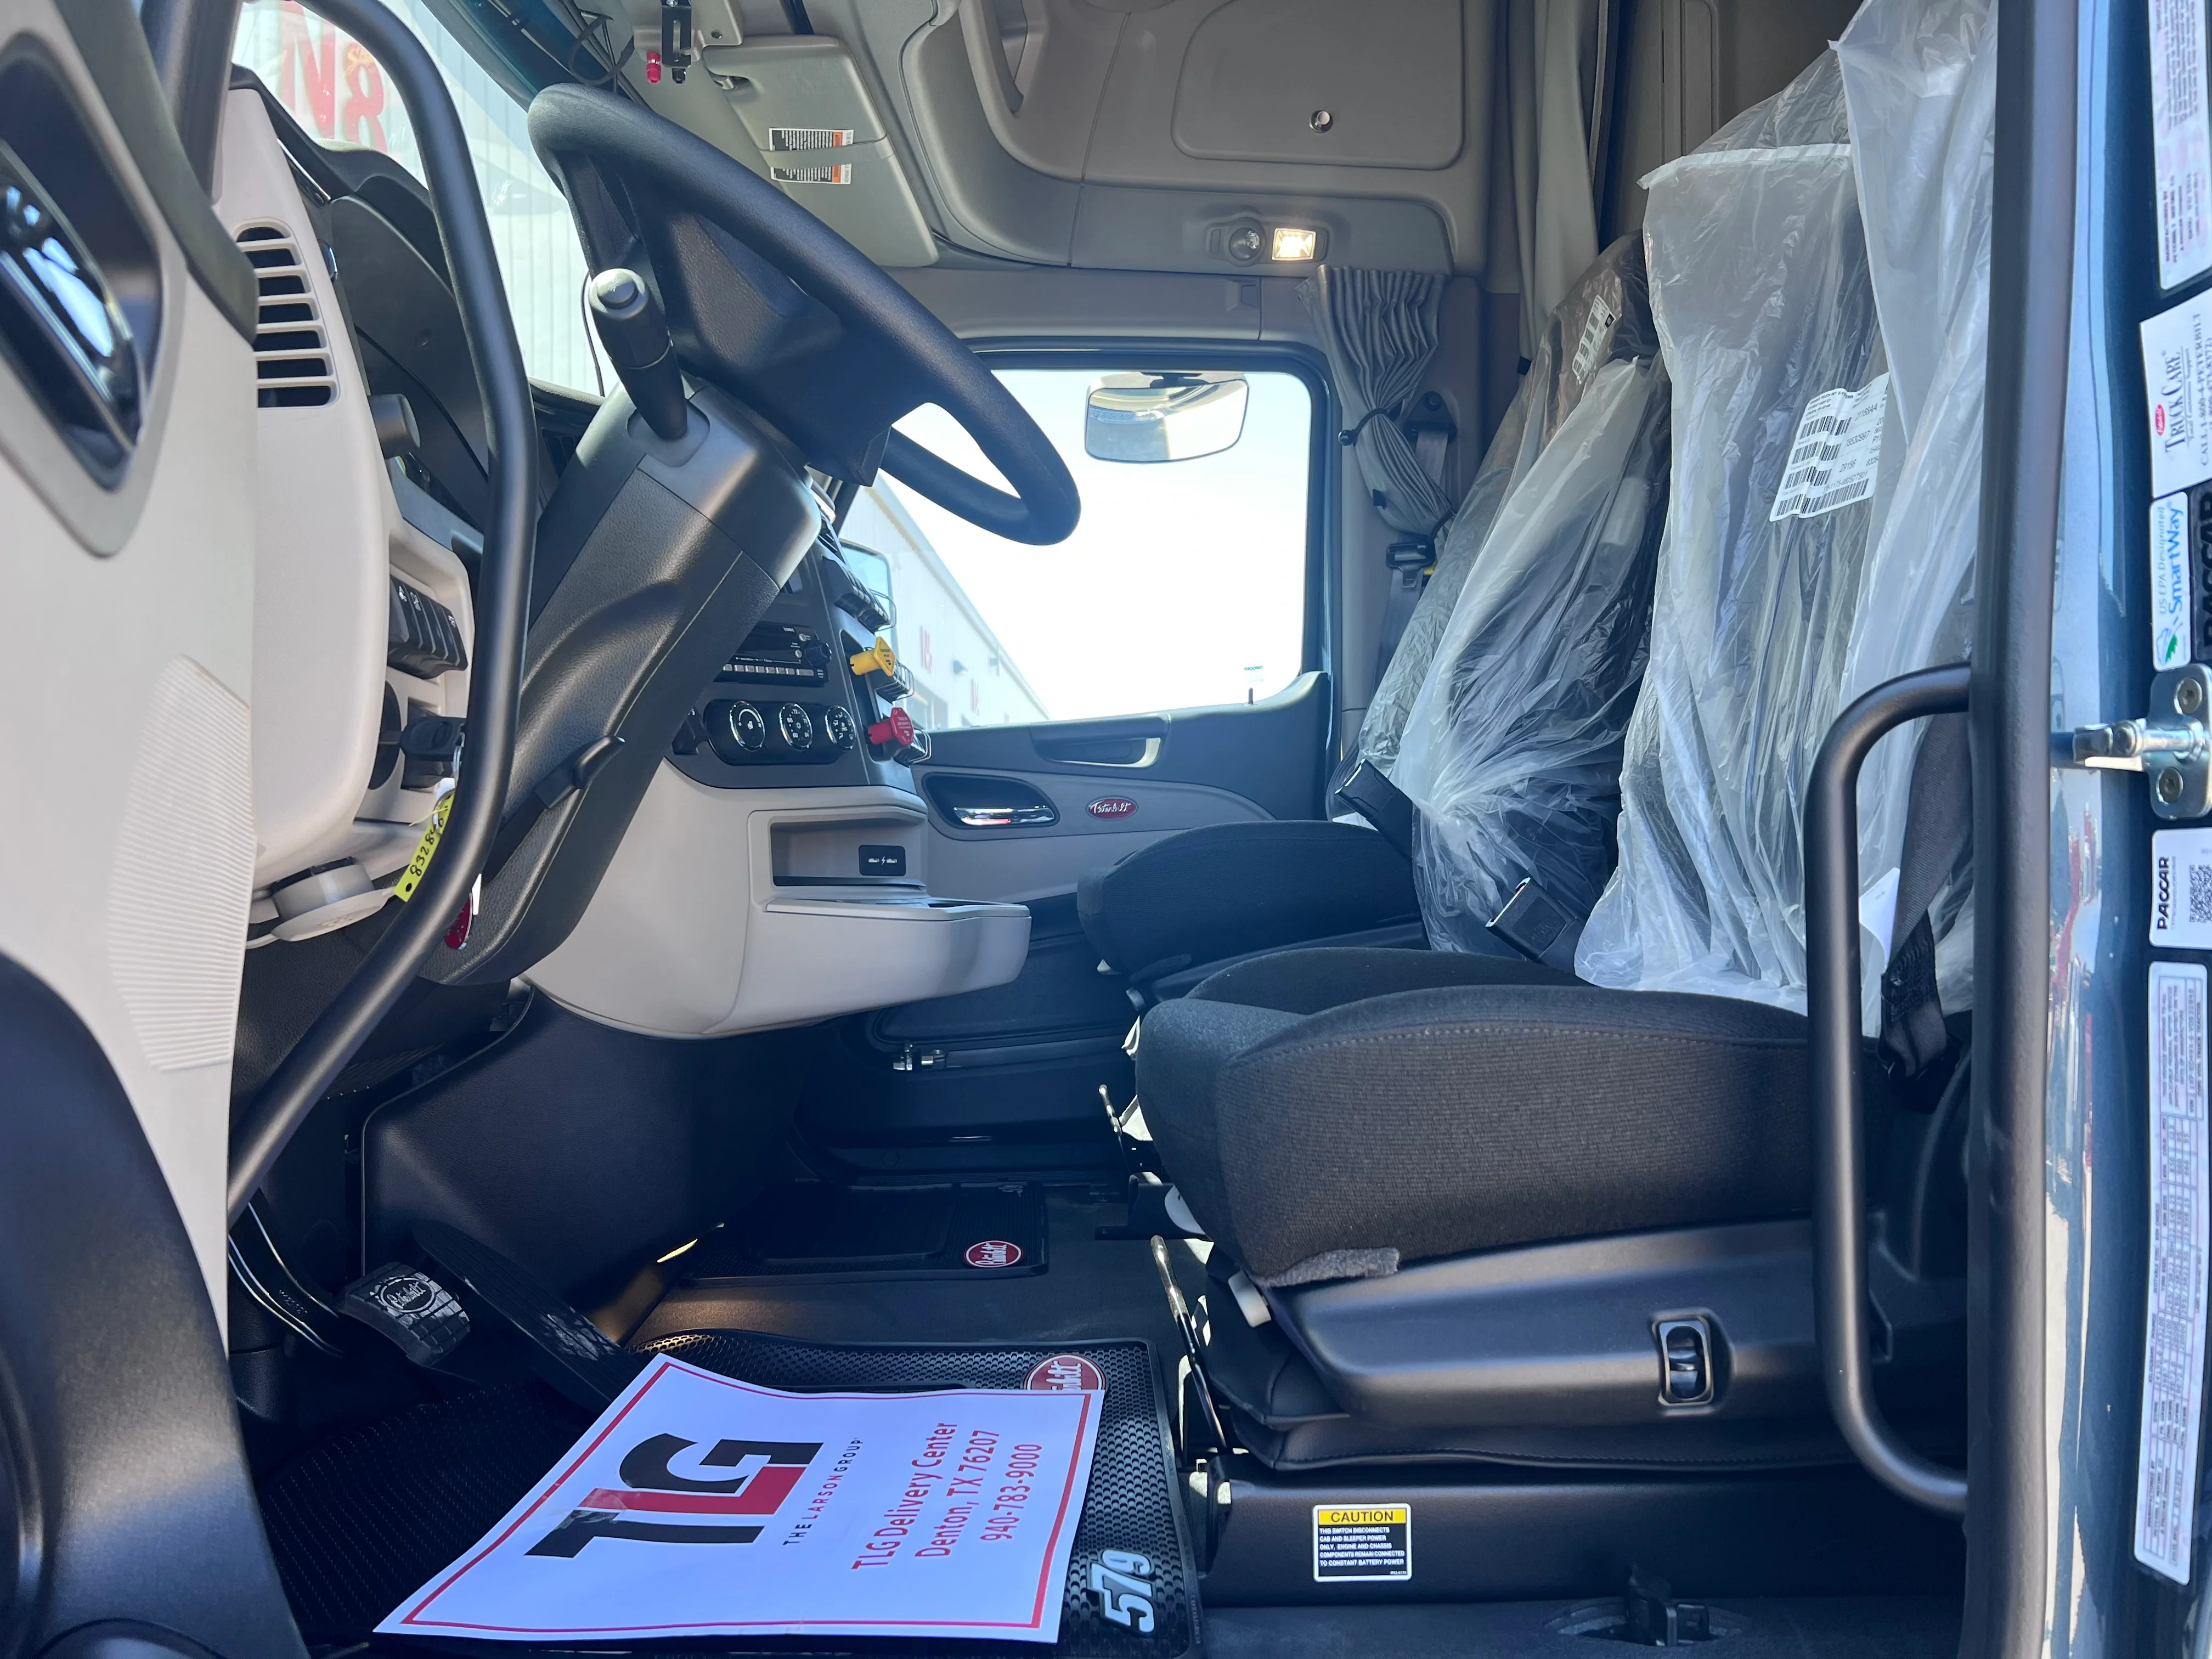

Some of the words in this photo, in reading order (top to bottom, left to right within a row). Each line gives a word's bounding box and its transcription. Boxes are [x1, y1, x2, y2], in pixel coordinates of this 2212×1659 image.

[2160, 351, 2182, 396] CARE
[2164, 395, 2186, 453] TRUCK
[2158, 506, 2168, 573] Designated
[2167, 508, 2185, 614] SmartWay
[2158, 574, 2167, 595] EPA
[2158, 598, 2167, 616] US
[1090, 800, 1131, 814] Peterbilt
[2157, 856, 2170, 930] PACCAR
[974, 1243, 1007, 1265] Peterbilt
[386, 1281, 427, 1310] Peterbilt
[911, 1422, 958, 1468] Center
[957, 1430, 1000, 1472] 76207
[523, 1433, 824, 1558] TLG
[782, 1523, 813, 1546] THE
[801, 1475, 844, 1520] LARSON
[834, 1438, 864, 1472] GROUP
[873, 1472, 944, 1537] Delivery
[946, 1477, 984, 1497] TX
[980, 1444, 1042, 1541] 940-783-9000
[914, 1501, 980, 1558] Denton,
[1331, 1511, 1393, 1523] CAUTION
[851, 1541, 902, 1570] TLG
[1091, 1549, 1155, 1633] 579
